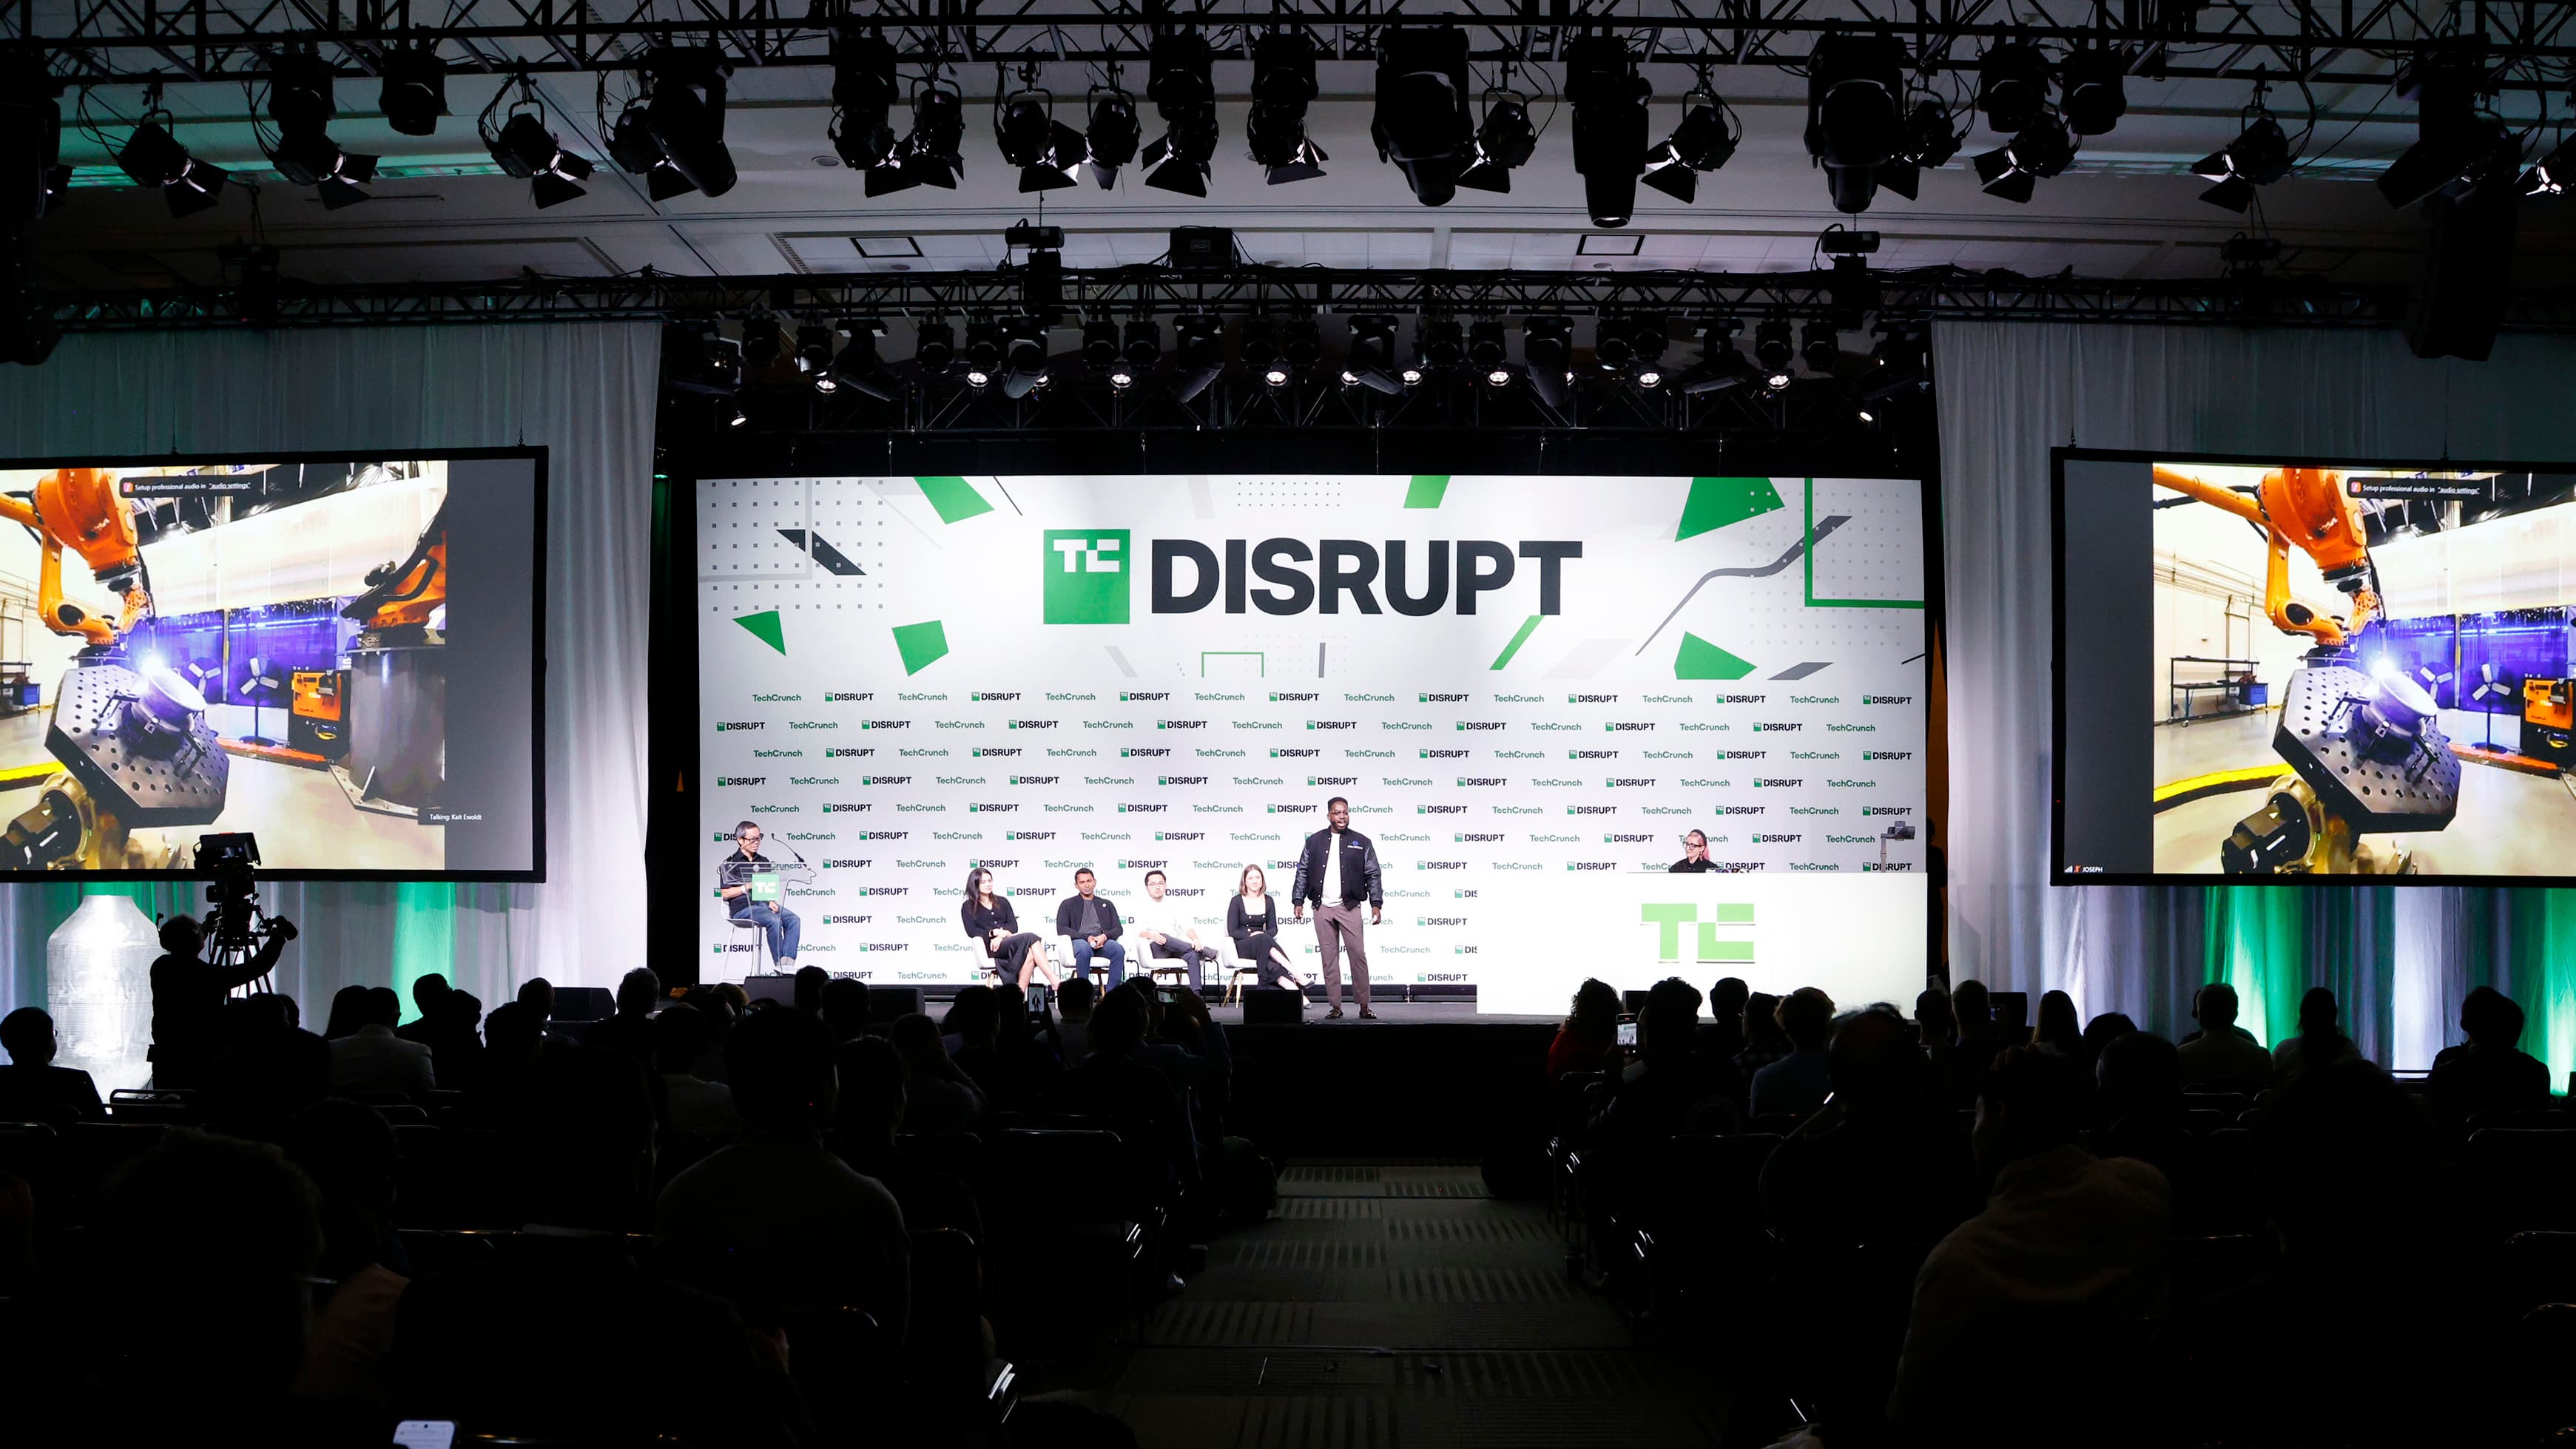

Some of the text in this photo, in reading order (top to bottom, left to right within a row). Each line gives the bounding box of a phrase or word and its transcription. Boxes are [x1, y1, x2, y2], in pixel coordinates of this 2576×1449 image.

[2362, 484, 2378, 493] Setup
[2379, 485, 2412, 493] professional
[1151, 537, 1582, 616] DISRUPT
[752, 692, 1912, 705] TechCrunch DISRUPT TechCrunch DISRUPT TechCrunch DISRUPT TechCrunch DISRUPT TechCrunch DISRUPT TechCrunch DISRUPT TechCrunch DISRUPT TechCrunch DISRUPT
[726, 720, 1876, 732] DISRUPT TechCrunch DISRUPT TechCrunch DISRUPT TechCrunch DISRUPT TechCrunch DISRUPT TechCrunch DISRUPT TechCrunch DISRUPT TechCrunch DISRUPT TechCrunch
[753, 748, 1912, 760] TechCrunch DISRUPT TechCrunch DISRUPT TechCrunch DISRUPT TechCrunch DISRUPT TechCrunch DISRUPT TechCrunch DISRUPT TechCrunch DISRUPT TechCrunch DISRUPT
[727, 776, 1876, 788] DISRUPT TechCrunch DISRUPT TechCrunch DISRUPT TechCrunch DISRUPT TechCrunch DISRUPT TechCrunch DISRUPT TechCrunch DISRUPT TechCrunch DISRUPT TechCrunch
[751, 804, 800, 814] TechCrunch
[833, 803, 871, 812] DISRUPT
[896, 803, 946, 812] TechCrunch
[980, 803, 1018, 812] DISRUPT
[1044, 804, 1094, 812] TechCrunch
[1128, 804, 1168, 812] DISRUPT
[1193, 804, 1244, 813] TechCrunch
[1278, 805, 1318, 813] DISRUPT
[1428, 805, 1468, 814] DISRUPT
[1492, 805, 1543, 814] TechCrunch
[1577, 806, 1617, 814] DISRUPT
[1642, 806, 1692, 815] TechCrunch
[1726, 806, 1766, 814] DISRUPT
[1790, 806, 1839, 815] TechCrunch
[1872, 807, 1912, 816] DISRUPT
[786, 832, 836, 841] TechCrunch
[869, 831, 908, 840] DISRUPT
[933, 831, 982, 840] TechCrunch
[1016, 831, 1056, 840] DISRUPT
[1081, 832, 1131, 840] TechCrunch
[1165, 832, 1205, 840] DISRUPT
[1230, 833, 1281, 841] TechCrunch
[1380, 833, 1431, 842] TechCrunch
[1465, 834, 1505, 842] DISRUPT
[1530, 834, 1580, 842] TechCrunch
[1614, 834, 1654, 842] DISRUPT
[1762, 834, 1802, 842] DISRUPT
[1826, 834, 1876, 843] TechCrunch
[833, 859, 872, 868] DISRUPT
[896, 859, 946, 868] TechCrunch
[1128, 860, 1168, 868] DISRUPT
[1428, 861, 1468, 870] DISRUPT
[1492, 862, 1543, 870] TechCrunch
[1577, 862, 1616, 871] DISRUPT
[1790, 862, 1840, 871] TechCrunch
[869, 888, 908, 896] DISRUPT
[1016, 888, 1056, 896] DISRUPT
[833, 916, 871, 924] DISRUPT
[897, 916, 946, 924] TechCrunch
[1428, 917, 1467, 926] DISRUPT
[1642, 904, 1754, 959] TC
[870, 943, 909, 951] DISRUPT
[1380, 945, 1431, 953] TechCrunch
[898, 971, 947, 979] TechCrunch
[1428, 973, 1468, 982] DISRUPT
